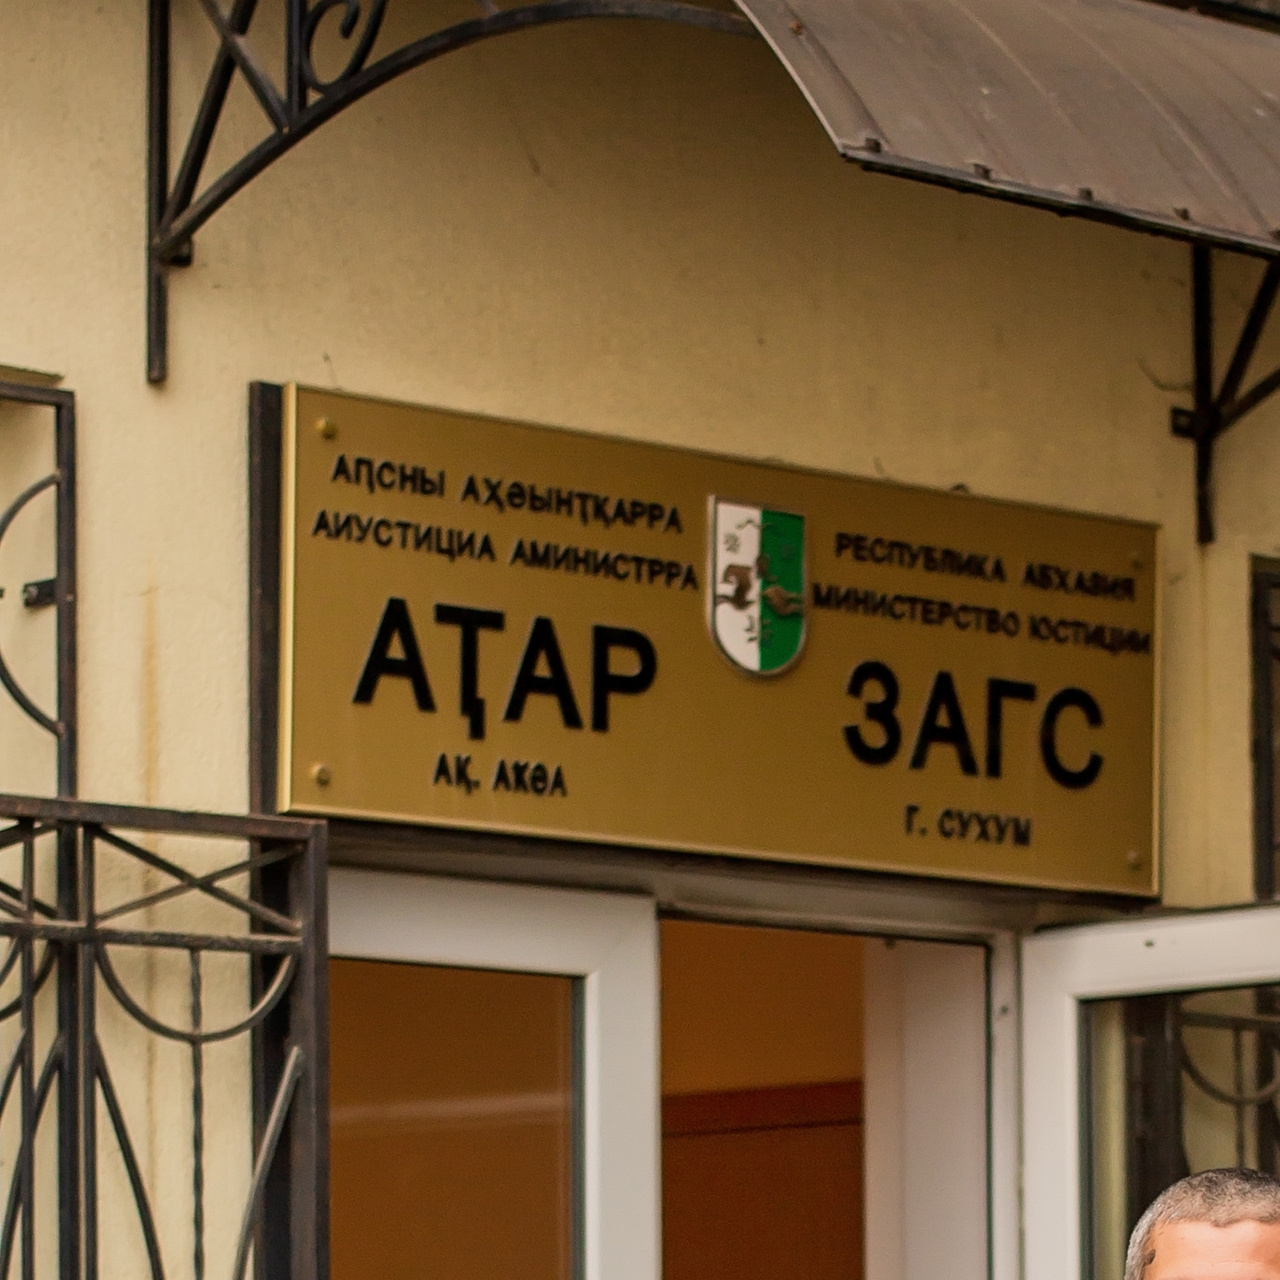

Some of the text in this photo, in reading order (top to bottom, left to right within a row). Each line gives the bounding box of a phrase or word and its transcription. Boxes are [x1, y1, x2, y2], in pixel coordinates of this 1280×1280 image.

[312, 509, 699, 591] АИУСТИЦИА АМИНИСТРРА
[835, 531, 1136, 602] РЕСПУБЛИКА АБХАЗИЯ
[811, 581, 1151, 656] МИНИСТЕРСТВО ЮСТИЦИИ
[843, 661, 1104, 790] ЗАГС
[938, 810, 1033, 847] СУХУМ
